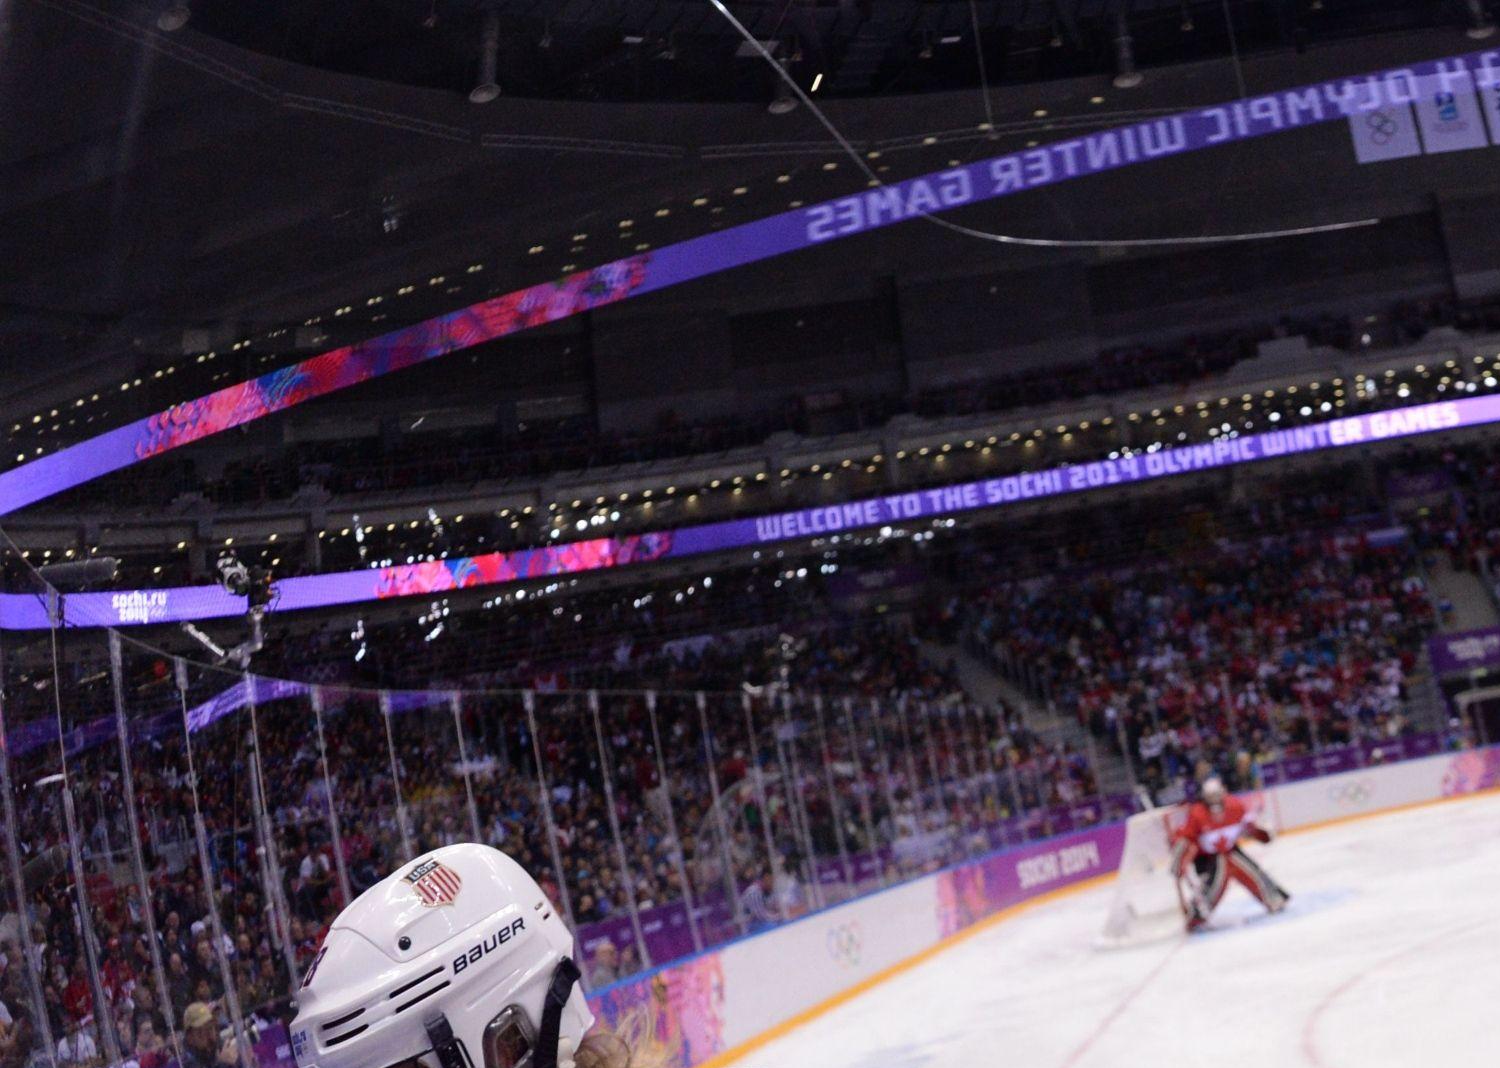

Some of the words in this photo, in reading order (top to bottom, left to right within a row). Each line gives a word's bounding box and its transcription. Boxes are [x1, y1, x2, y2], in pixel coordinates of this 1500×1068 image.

[756, 499, 880, 542] WELCOME
[886, 493, 922, 518] TO
[927, 483, 980, 511] THE
[986, 467, 1062, 503] SOCHI
[1071, 457, 1140, 490] 2014
[1146, 437, 1254, 476] OLYMPIC
[1261, 417, 1366, 456] WINTER
[1371, 401, 1460, 439] GAMES
[112, 590, 167, 609] sochi.ru
[453, 917, 526, 976] BAUER
